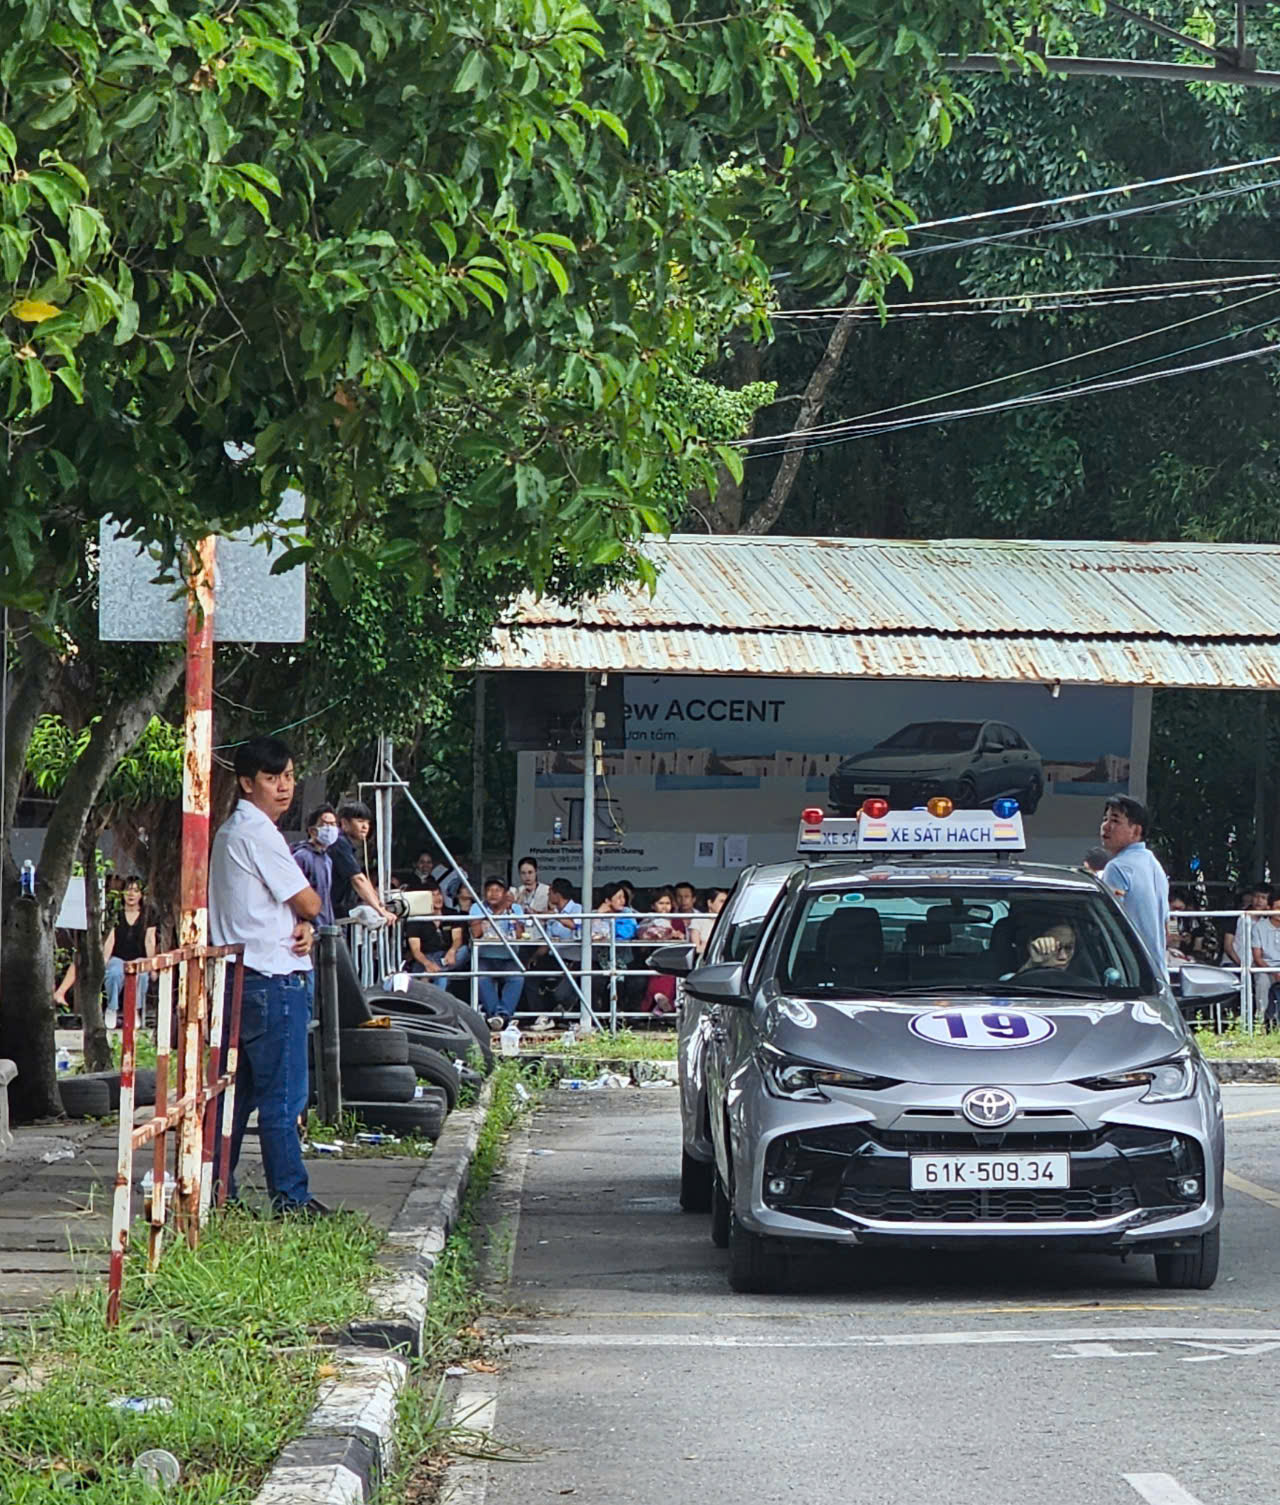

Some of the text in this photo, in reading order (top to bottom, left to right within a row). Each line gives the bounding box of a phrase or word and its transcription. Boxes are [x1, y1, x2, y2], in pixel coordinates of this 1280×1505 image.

[624, 699, 786, 722] ew ACCENT
[823, 829, 859, 845] XE SÁ
[891, 827, 909, 843] XE
[914, 822, 942, 843] SÁT
[932, 1012, 1030, 1039] 19
[925, 1161, 1054, 1183] 61K-509.34
